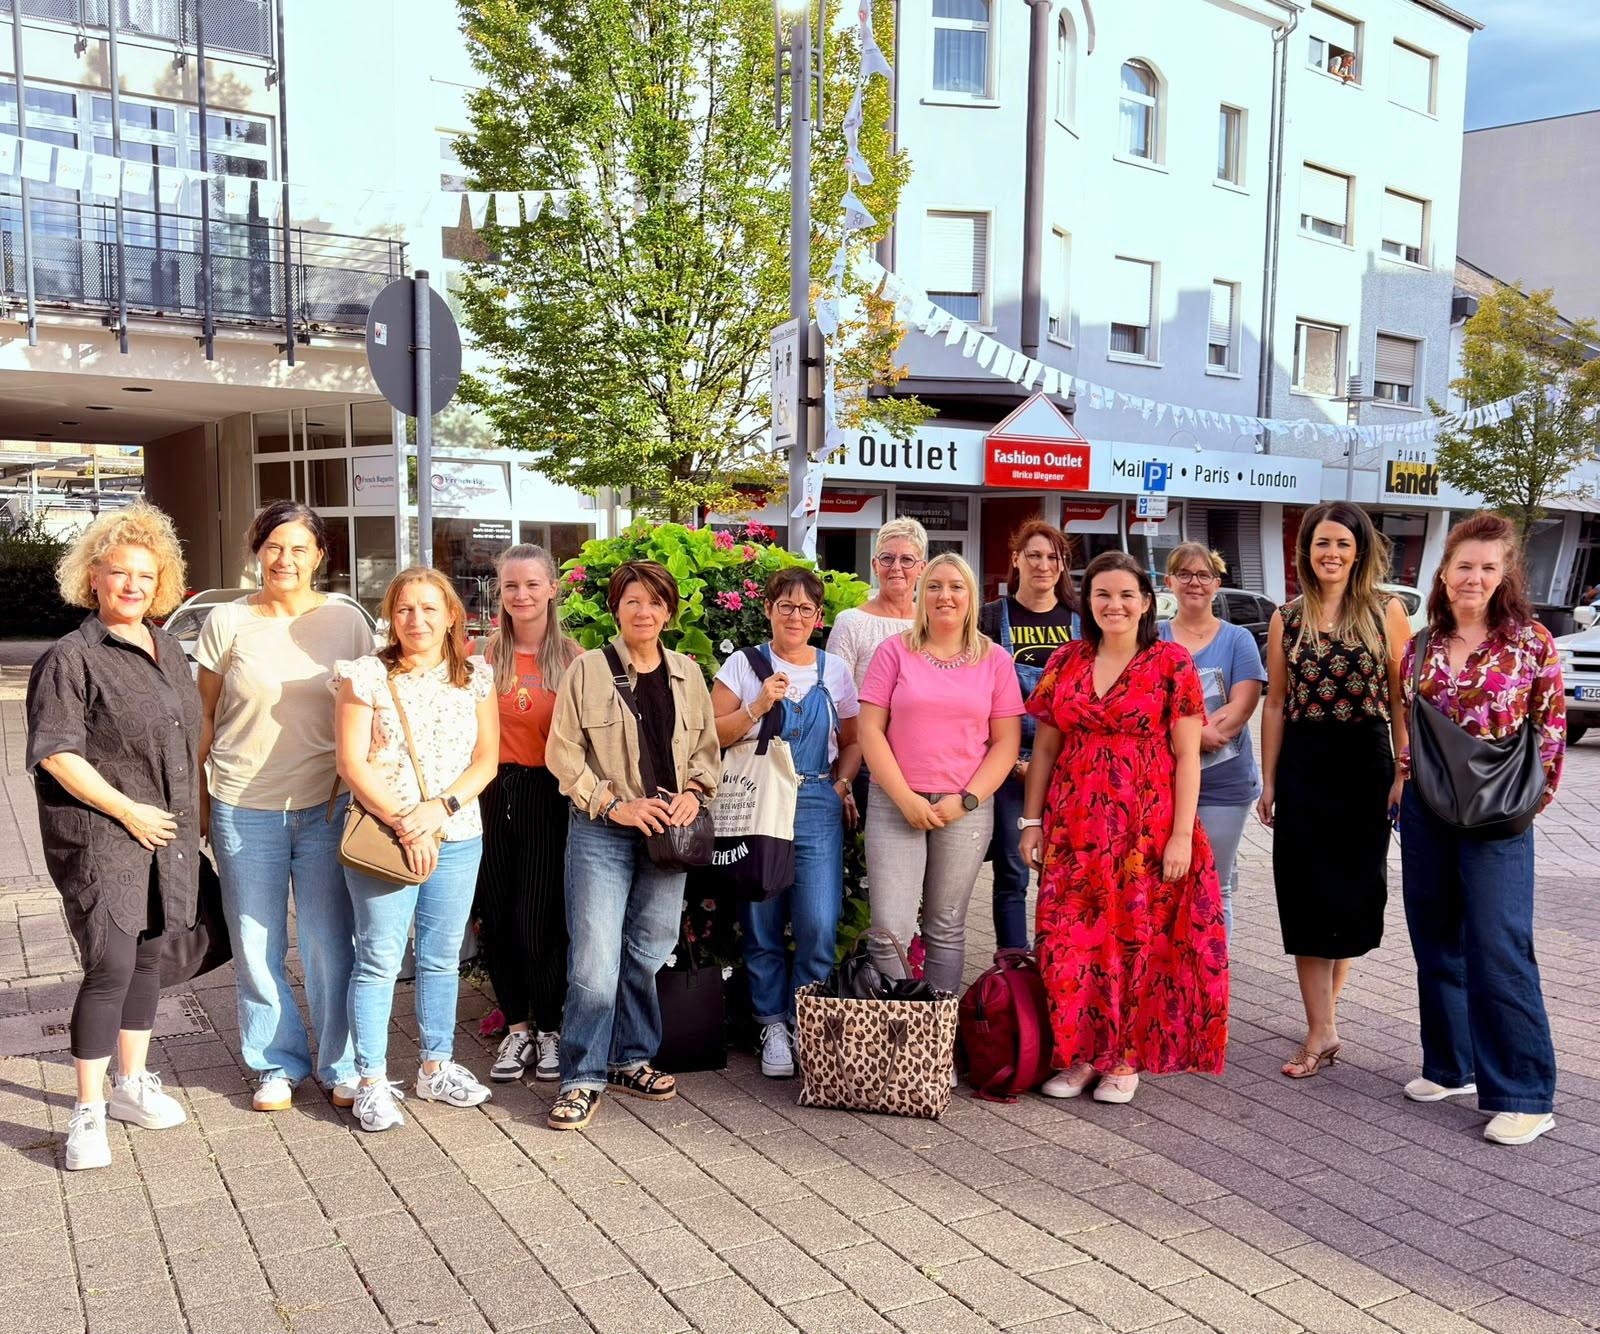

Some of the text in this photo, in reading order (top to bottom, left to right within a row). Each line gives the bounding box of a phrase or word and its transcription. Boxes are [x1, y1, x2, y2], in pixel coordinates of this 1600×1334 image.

[858, 435, 958, 472] Outlet
[994, 449, 1083, 468] Fashion Outlet
[1397, 449, 1427, 463] PIANO
[1011, 469, 1065, 482] Ulrike Wegener
[1113, 457, 1297, 489] Maild Paris London
[1385, 460, 1440, 496] Landt
[1008, 625, 1073, 645] NIRVAN
